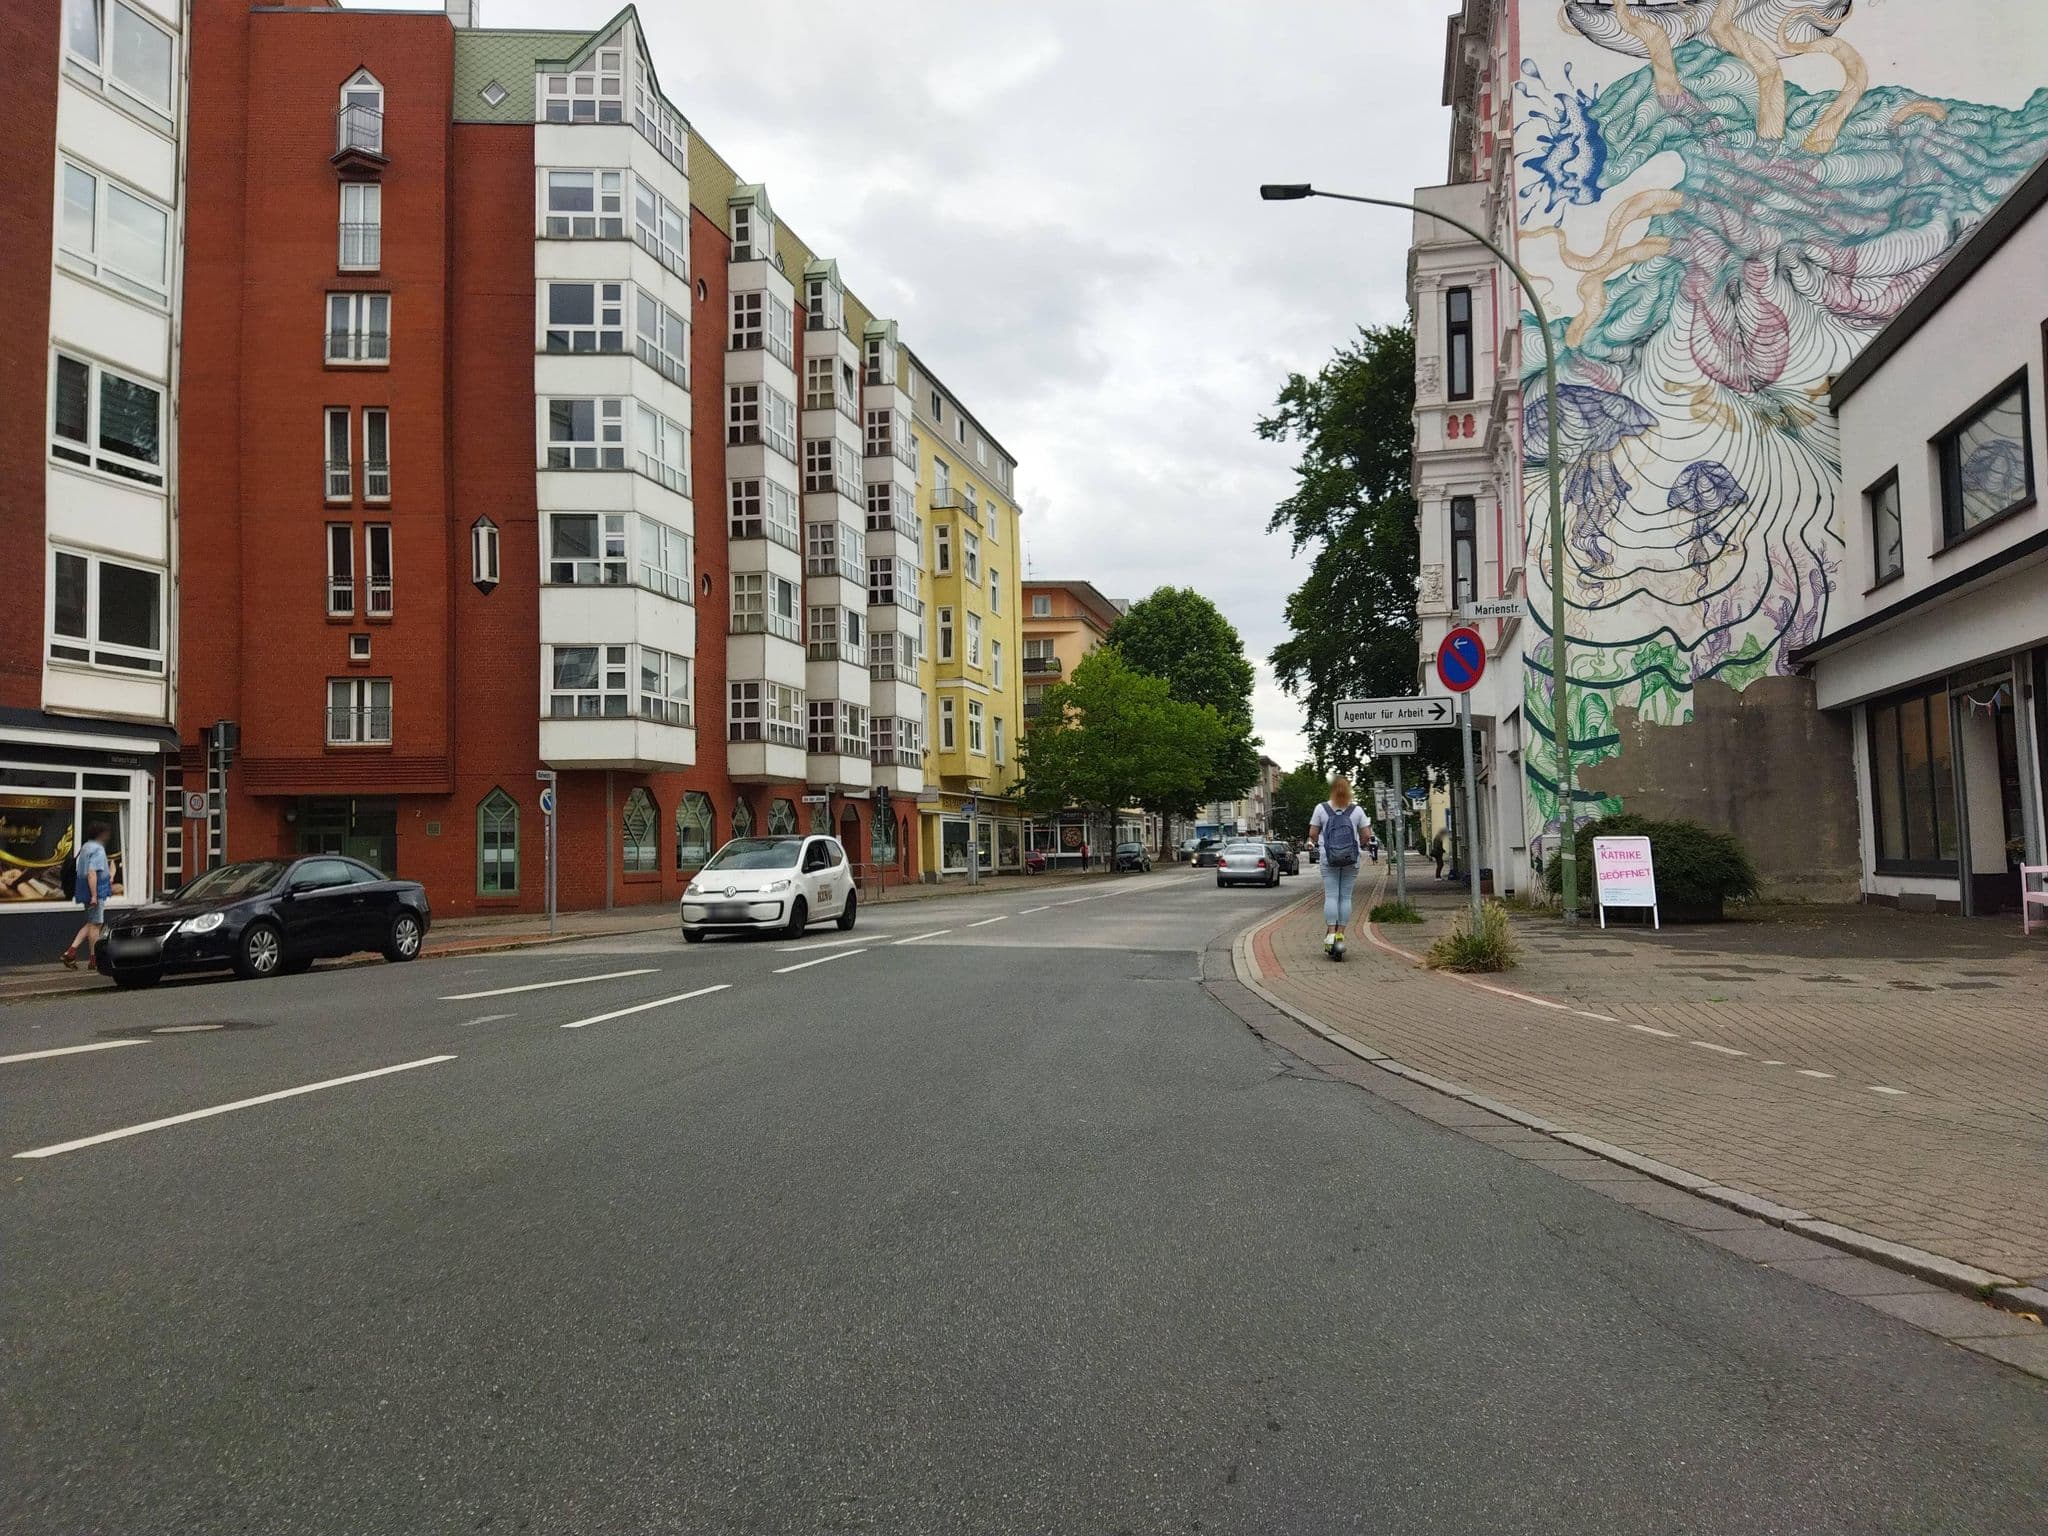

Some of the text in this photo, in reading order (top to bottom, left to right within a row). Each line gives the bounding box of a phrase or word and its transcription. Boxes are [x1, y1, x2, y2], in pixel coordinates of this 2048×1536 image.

[1475, 604, 1521, 615] Marienstr.
[1344, 708, 1424, 723] Agentur für Arbeit
[1601, 850, 1642, 860] KATRIKE
